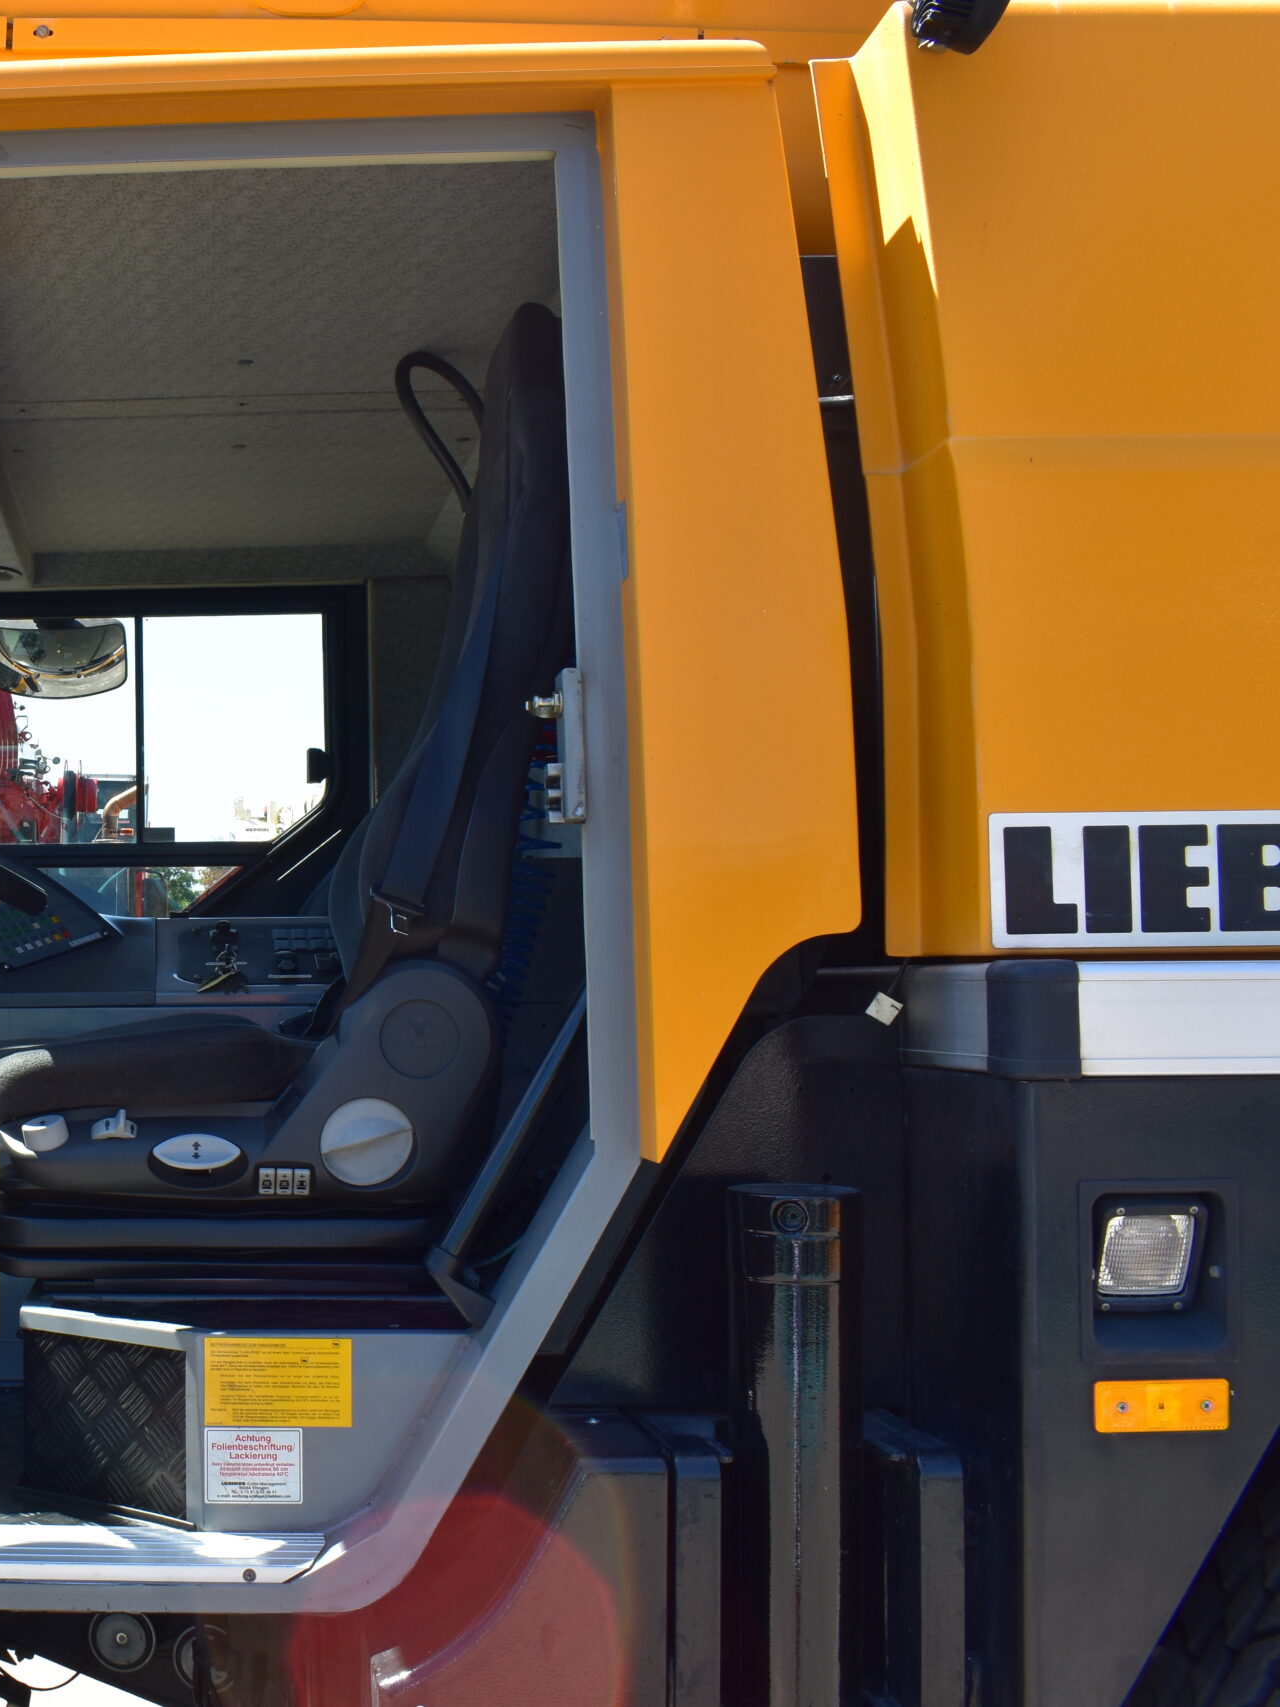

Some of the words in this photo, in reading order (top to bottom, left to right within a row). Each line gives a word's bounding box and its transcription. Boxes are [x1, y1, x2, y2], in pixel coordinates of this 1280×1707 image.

[1002, 823, 1280, 935] LIEB
[235, 1434, 272, 1444] Achtung
[229, 1452, 278, 1461] Lackierung
